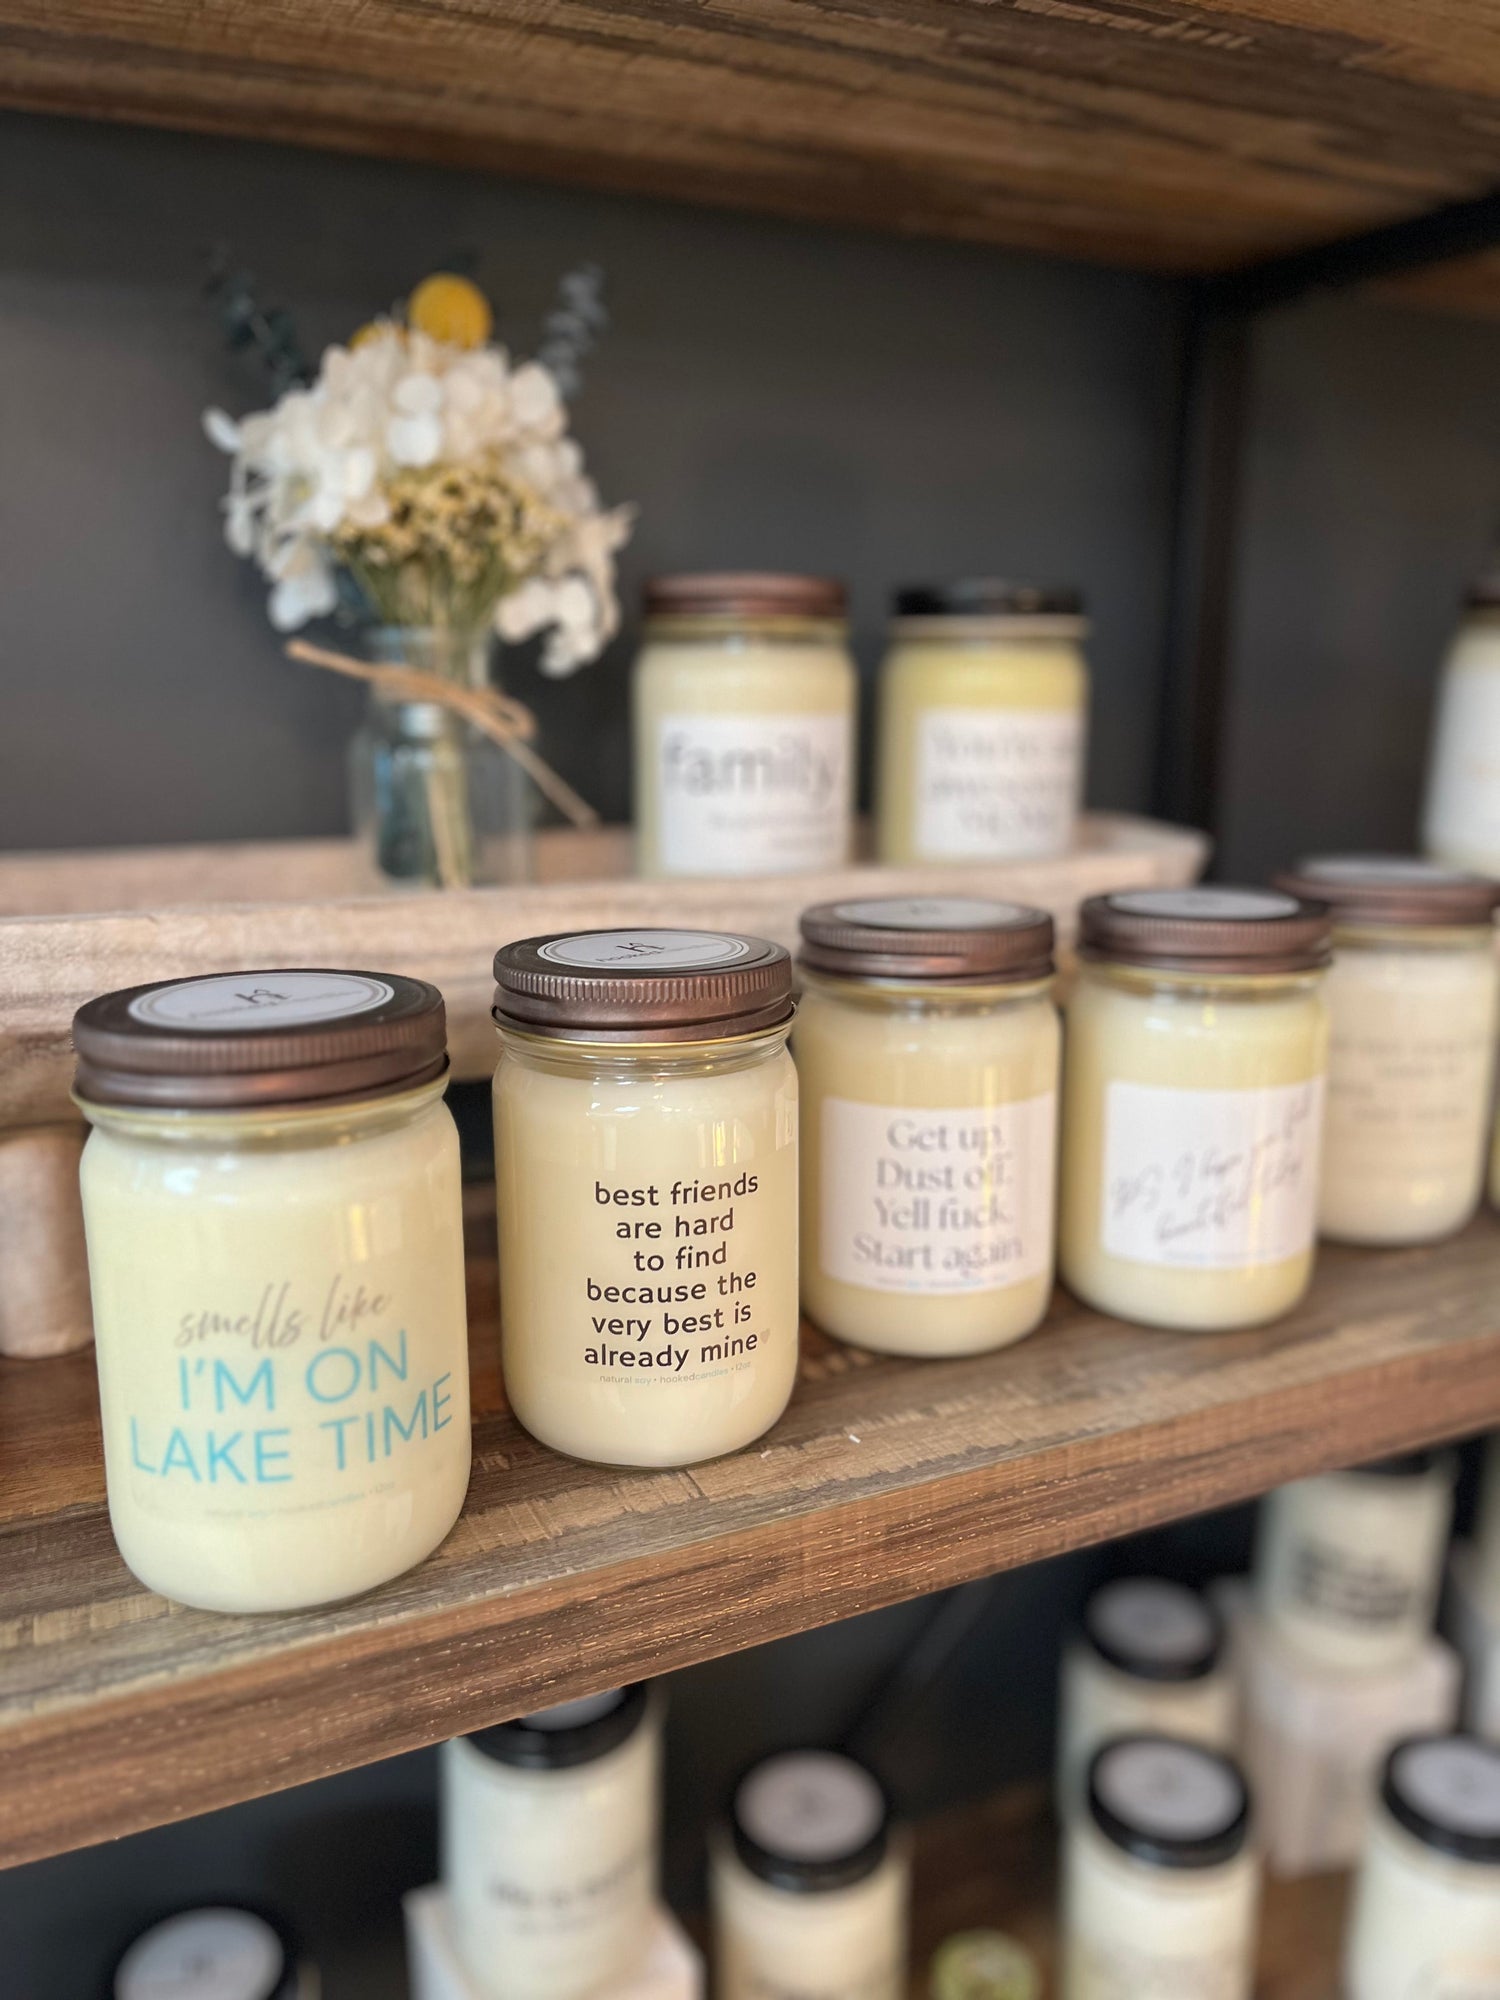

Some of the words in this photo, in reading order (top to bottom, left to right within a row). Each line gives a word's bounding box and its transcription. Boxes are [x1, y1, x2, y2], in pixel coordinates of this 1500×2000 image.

[886, 1118, 949, 1151] Get
[595, 1181, 660, 1206] best
[670, 1172, 758, 1205] friends
[876, 1157, 955, 1191] Dust
[616, 1221, 662, 1239] are
[675, 1207, 734, 1238] hard
[873, 1197, 931, 1231] Yell
[633, 1250, 665, 1272] to
[675, 1241, 727, 1270] find
[852, 1231, 933, 1270] Start
[586, 1277, 707, 1304] because
[717, 1271, 757, 1296] the
[175, 1281, 302, 1349] smells
[319, 1273, 391, 1342] like
[591, 1316, 652, 1342] very
[663, 1308, 725, 1335] best
[733, 1300, 752, 1324] is
[584, 1343, 690, 1372] already
[700, 1333, 758, 1363] mine
[179, 1355, 276, 1413] I'M
[305, 1328, 408, 1404] ON
[599, 1374, 632, 1385] natural
[634, 1376, 651, 1386] soy
[659, 1367, 729, 1384] hookedcandles
[130, 1414, 294, 1484] LAKE
[319, 1371, 453, 1471] TIME
